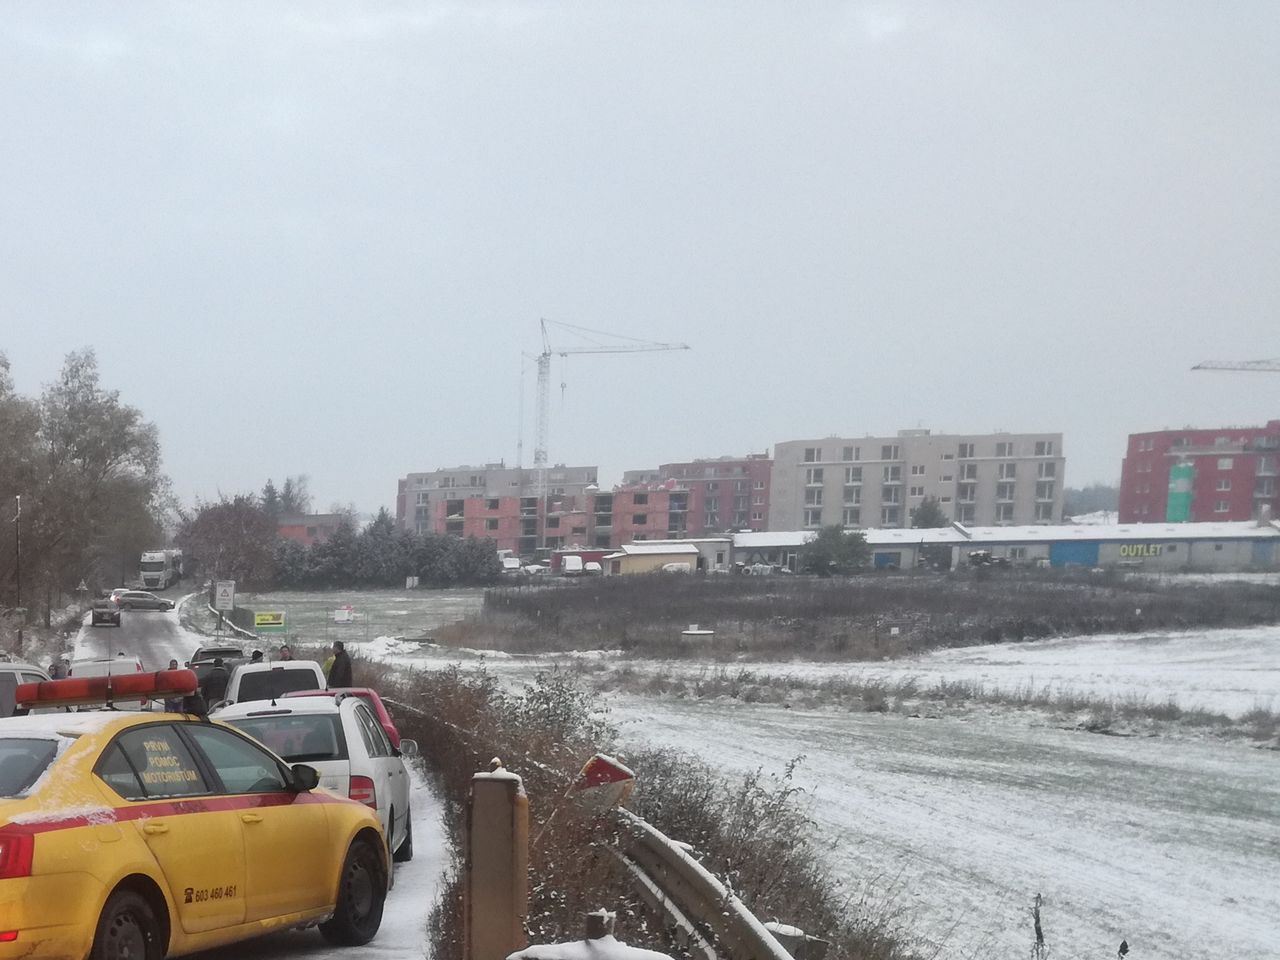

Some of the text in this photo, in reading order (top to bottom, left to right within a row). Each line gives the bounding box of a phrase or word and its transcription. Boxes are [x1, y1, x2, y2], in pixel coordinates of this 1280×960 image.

[1120, 544, 1161, 557] OUTLET
[149, 756, 180, 768] POMOC
[195, 889, 208, 902] 603
